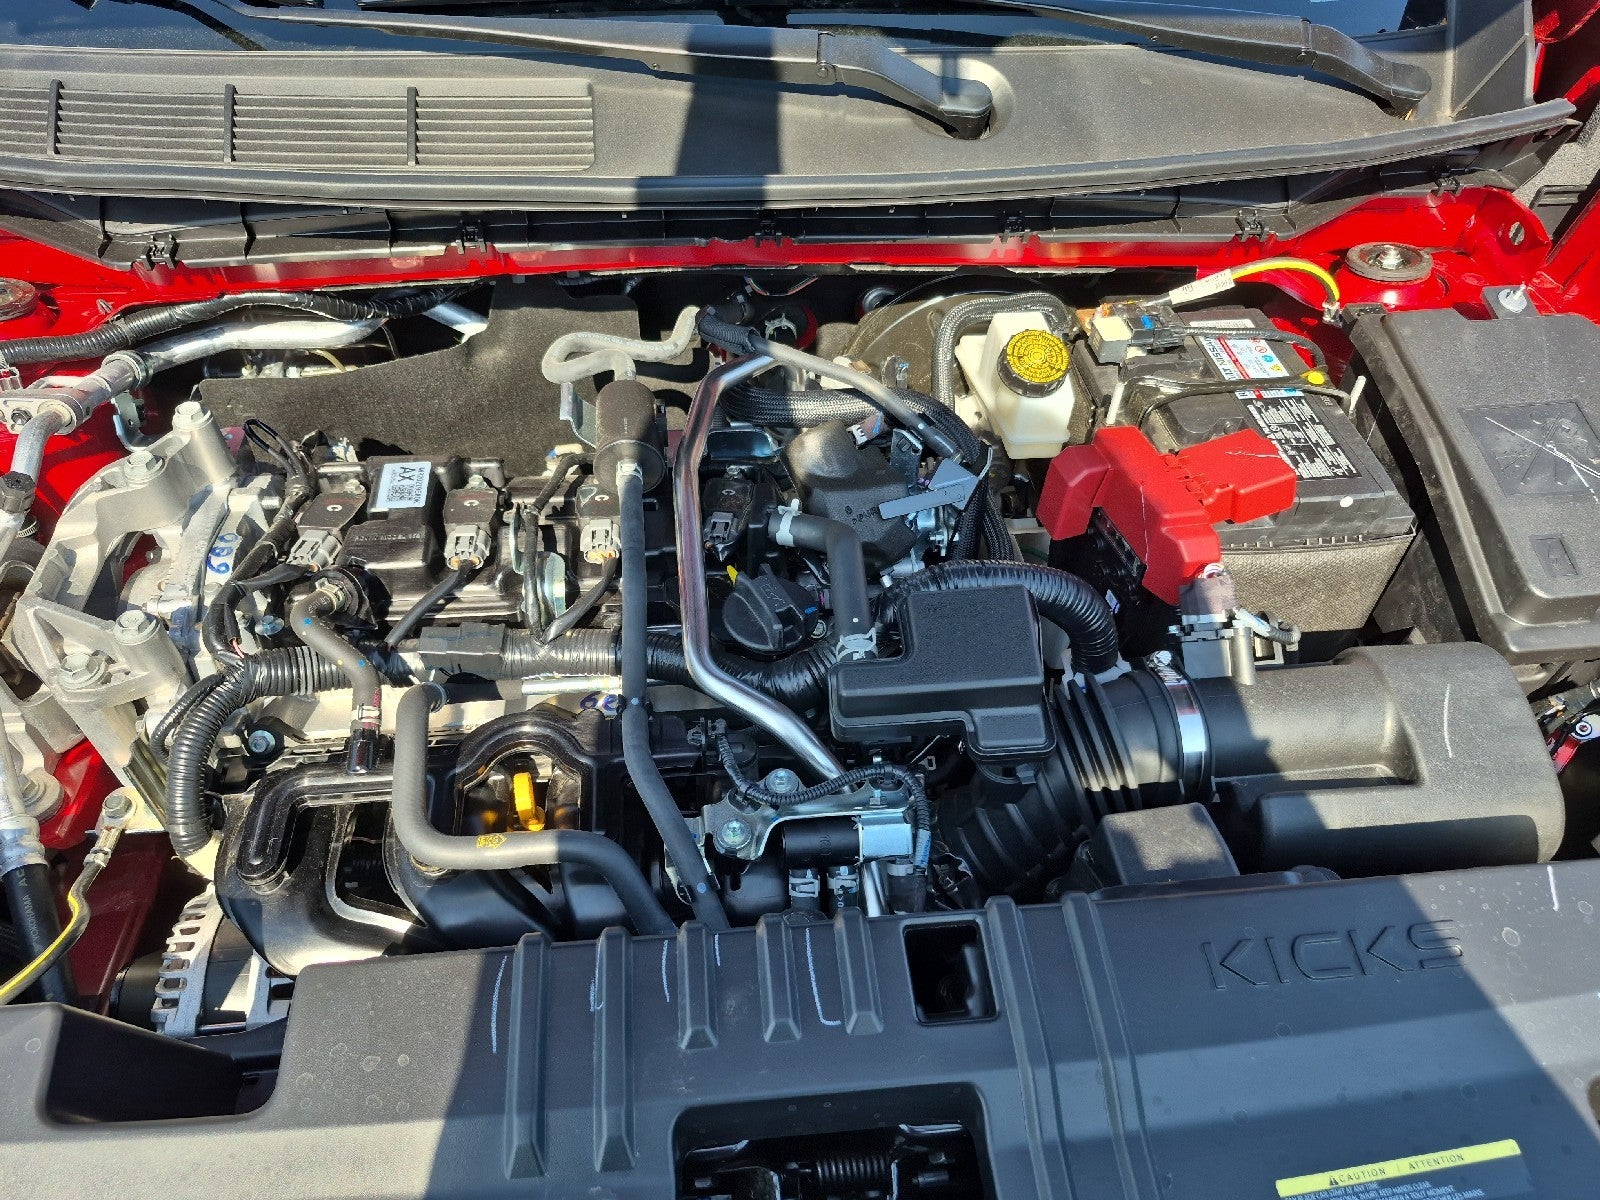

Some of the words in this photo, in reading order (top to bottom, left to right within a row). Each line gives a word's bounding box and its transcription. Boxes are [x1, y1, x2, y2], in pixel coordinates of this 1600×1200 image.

[397, 466, 416, 482] AX
[22, 893, 41, 943] YOKOHAMA
[1200, 919, 1464, 990] KICKS
[1339, 1167, 1386, 1183] CAUTION
[1408, 1153, 1465, 1172] ATTENTION
